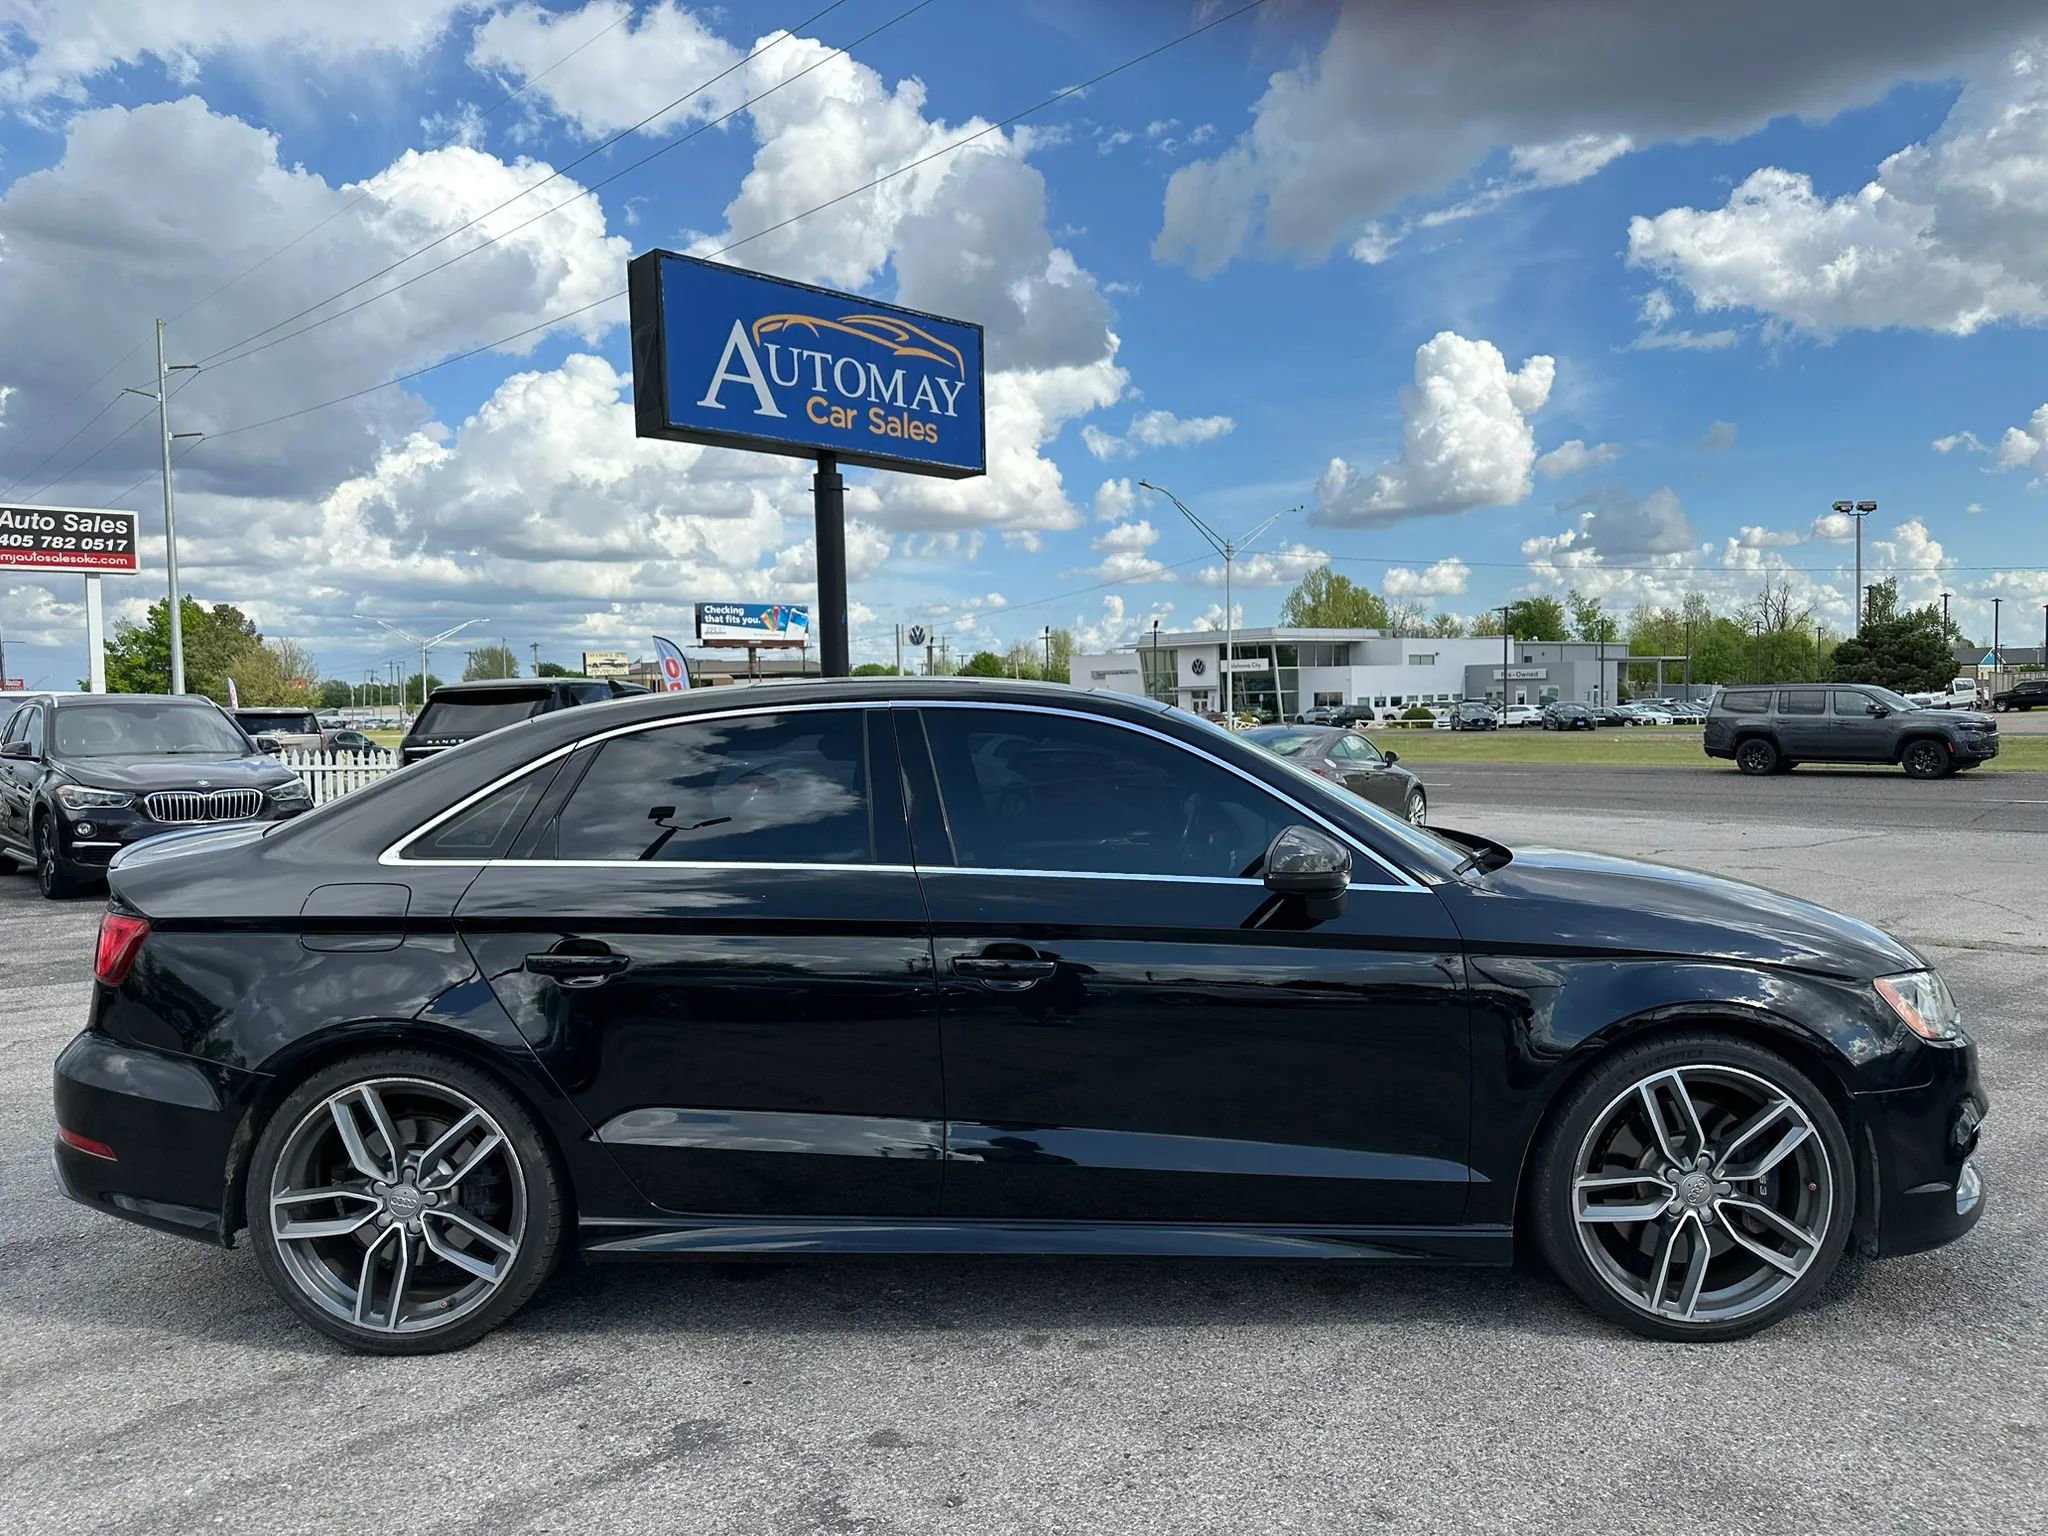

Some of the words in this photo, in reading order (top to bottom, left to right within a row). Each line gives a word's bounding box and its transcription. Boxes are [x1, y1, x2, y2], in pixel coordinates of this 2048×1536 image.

[697, 319, 966, 419] AUTOMAY
[806, 396, 857, 429] Car
[869, 407, 939, 444] Sales
[0, 510, 55, 531] Auto
[63, 513, 128, 534] Sales
[0, 533, 34, 547] 405
[40, 536, 76, 549] 782
[81, 538, 128, 551] 0517
[704, 605, 744, 616] Checking
[704, 615, 724, 624] that
[725, 615, 741, 624] fits
[742, 617, 761, 626] you.
